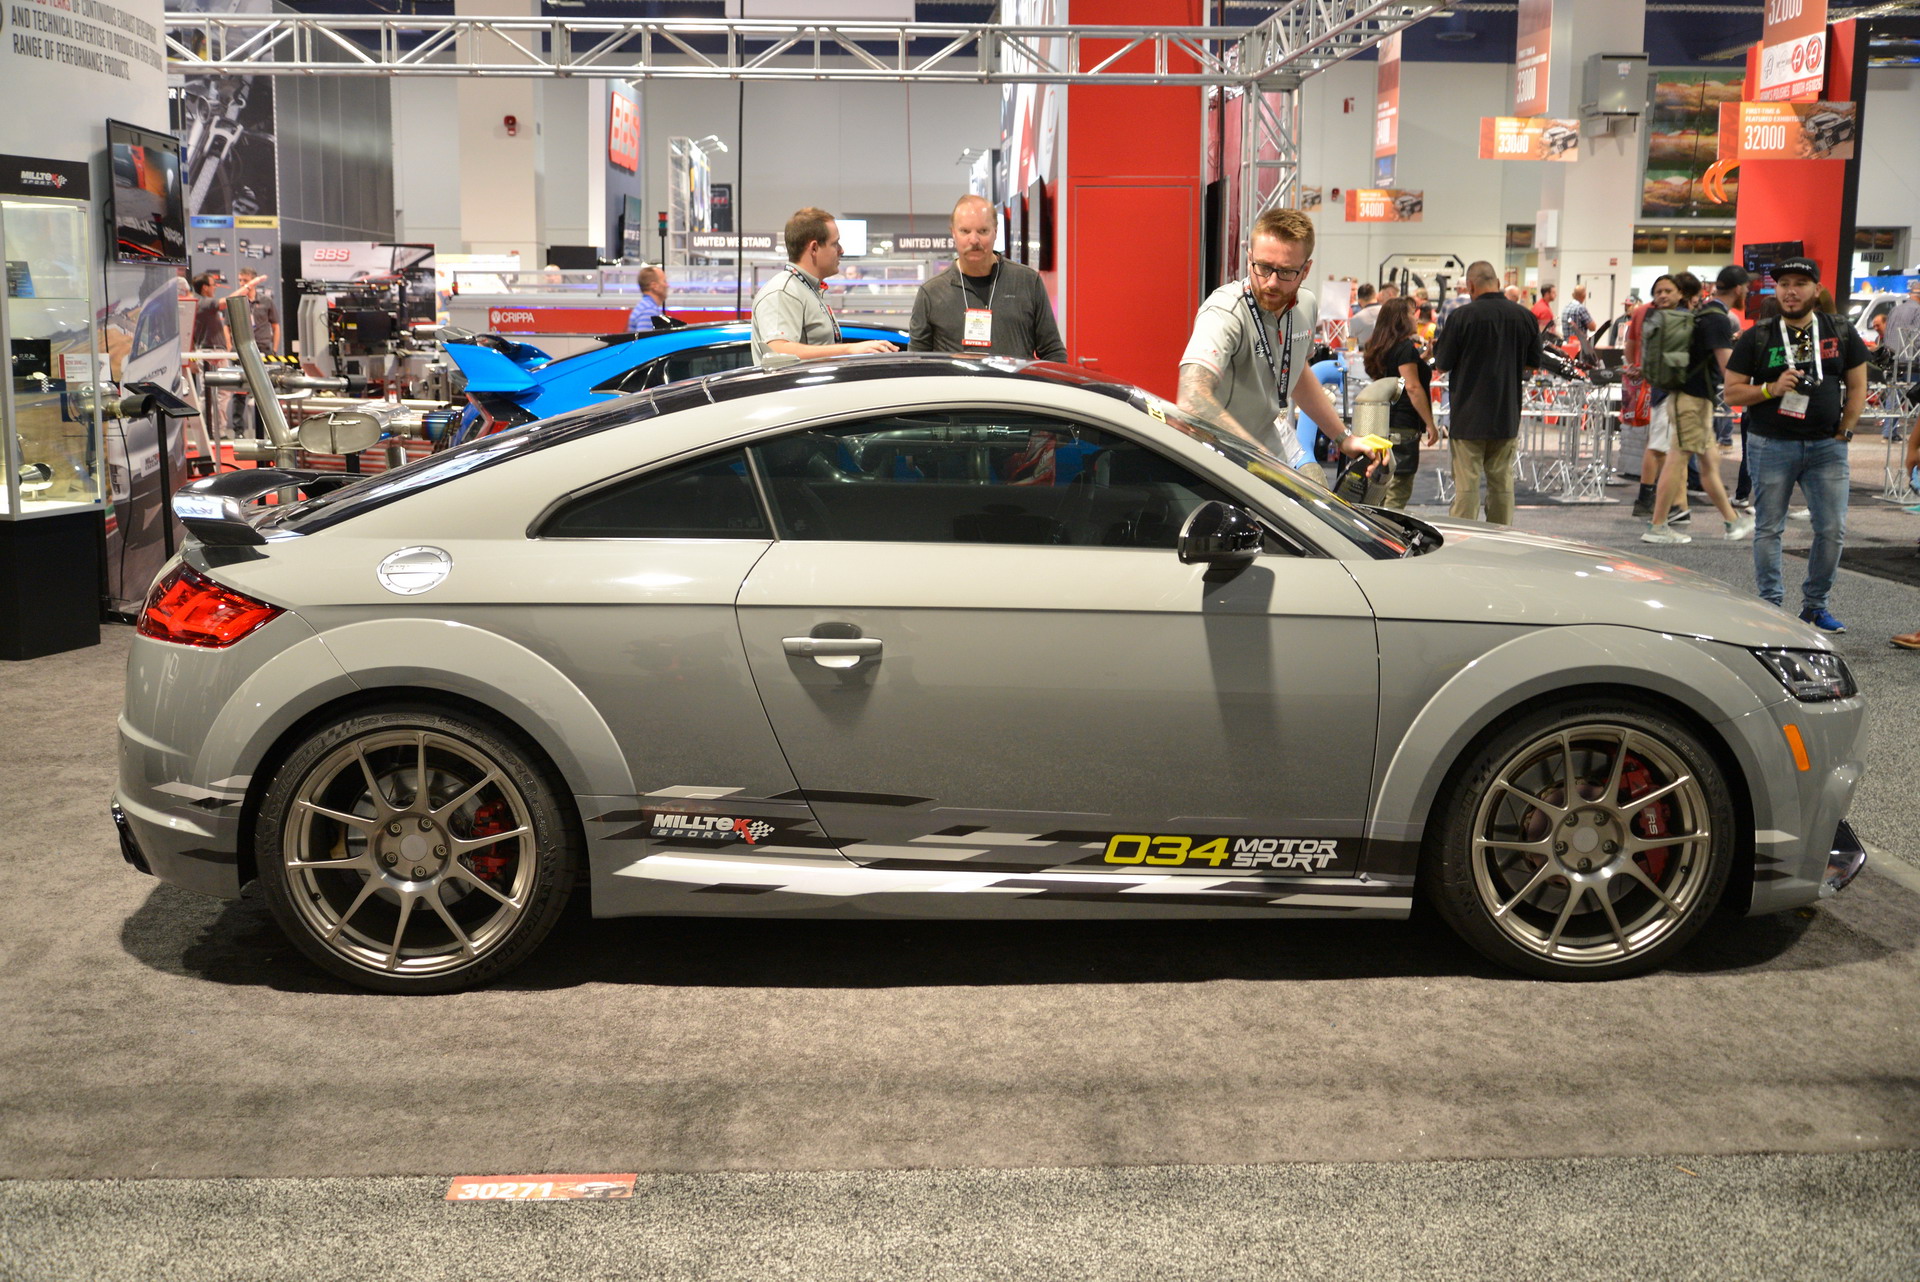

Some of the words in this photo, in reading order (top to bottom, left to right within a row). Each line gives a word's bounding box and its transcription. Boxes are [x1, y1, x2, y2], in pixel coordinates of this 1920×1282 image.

[1768, 0, 1802, 26] 32000
[12, 5, 30, 28] AND
[32, 10, 73, 38] TECHNICAL
[75, 20, 106, 48] EXPERTISE
[106, 30, 113, 50] TO
[13, 33, 42, 58] RANGE
[44, 40, 54, 60] OF
[56, 42, 103, 72] PERFORMANCE
[610, 91, 640, 163] BBS
[1498, 134, 1529, 153] 33000
[1744, 125, 1786, 150] 32000
[1360, 202, 1384, 217] 34000
[694, 236, 725, 248] UNITED
[726, 236, 740, 248] WE
[742, 236, 771, 248] STAND
[900, 238, 931, 248] UNITED
[932, 238, 946, 248] WE
[314, 249, 350, 261] BBS
[502, 312, 535, 323] CRIPPA
[656, 828, 730, 838] SPORT
[1646, 814, 1658, 835] RS
[1104, 834, 1229, 866] 034
[1233, 838, 1338, 858] MOTOR
[1232, 853, 1333, 872] SPORT
[457, 1182, 554, 1199] 30271
